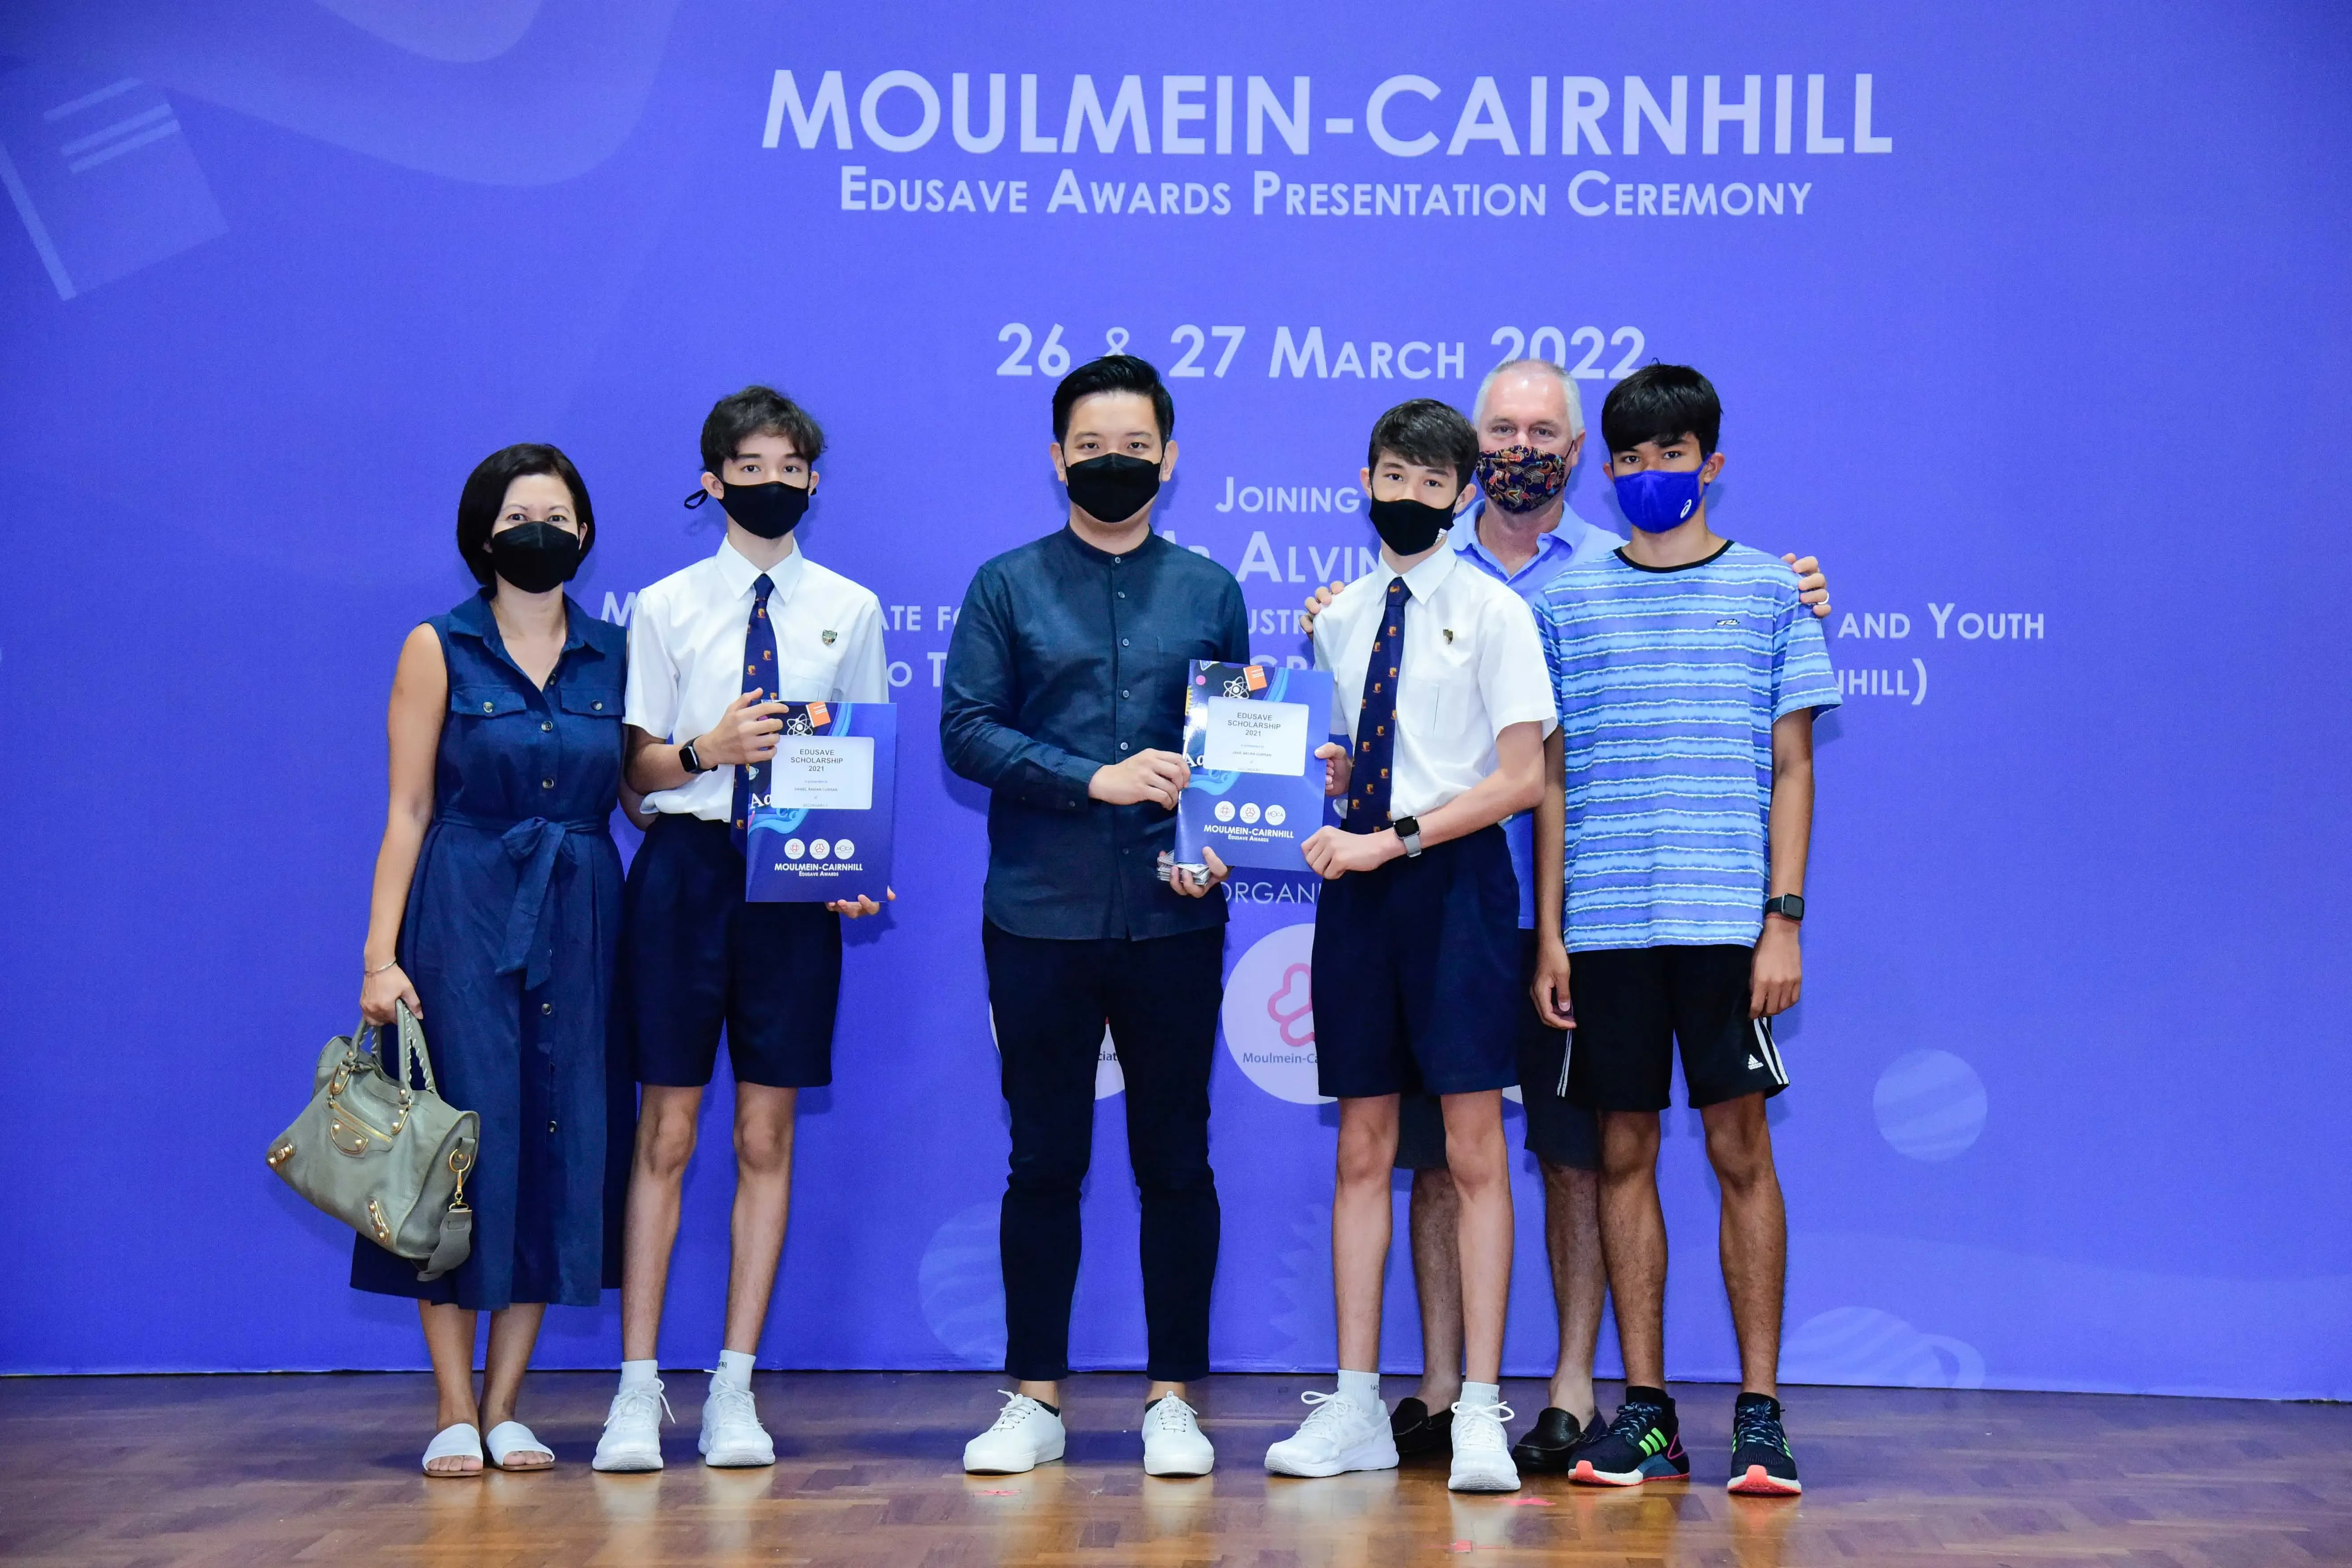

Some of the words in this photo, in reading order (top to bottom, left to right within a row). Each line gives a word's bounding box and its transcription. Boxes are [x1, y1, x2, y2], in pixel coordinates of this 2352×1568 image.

[763, 70, 1893, 157] MOULMEIN-CAIRNHILL
[996, 323, 1070, 377] 26
[1169, 324, 1246, 378] 27
[1490, 326, 1645, 379] 2022
[1237, 712, 1273, 721] EDUSAVE
[1228, 720, 1281, 730] SCHOLARSHIP
[1203, 824, 1295, 839] MOULMEIN-CAIRNHILL
[774, 863, 863, 871] MOULMEIN-CAIRNHILL
